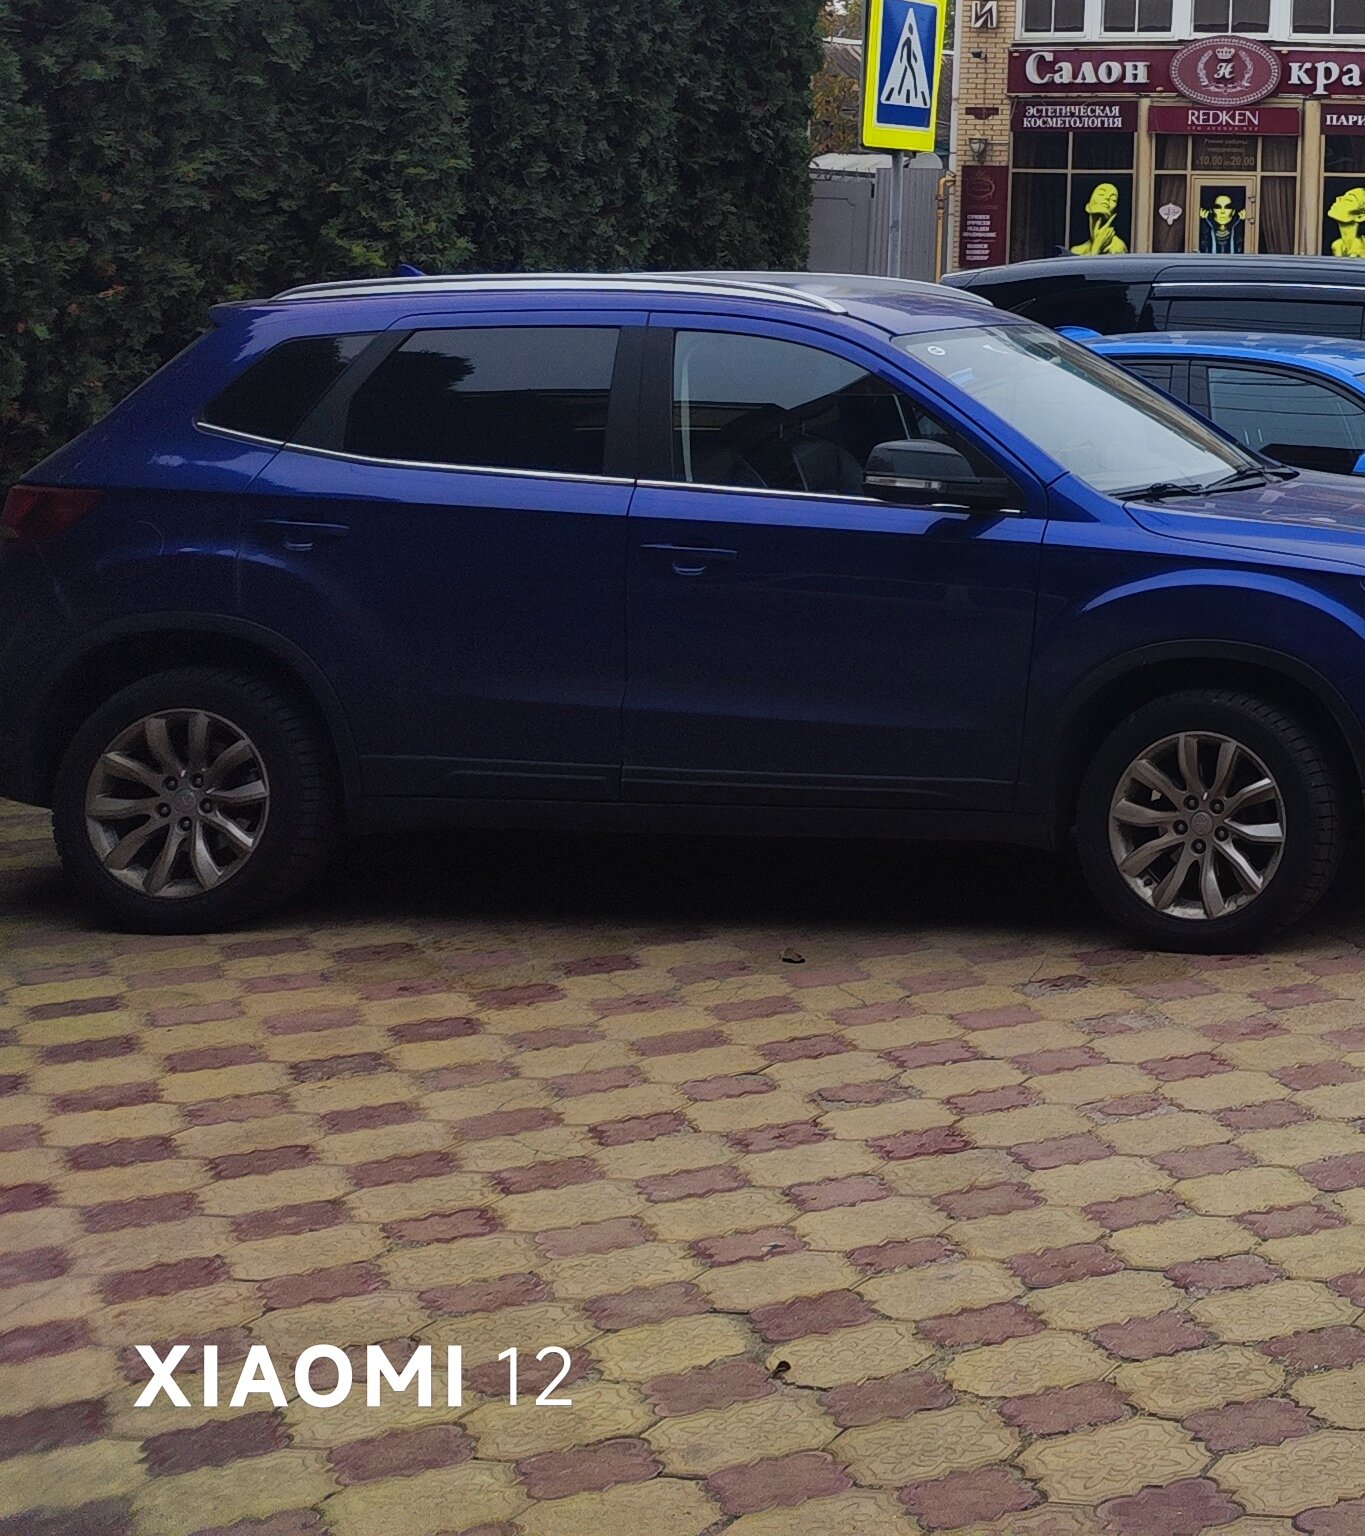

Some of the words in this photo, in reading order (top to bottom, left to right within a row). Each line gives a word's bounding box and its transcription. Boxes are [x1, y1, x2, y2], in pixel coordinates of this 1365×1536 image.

[1025, 51, 1150, 85] Салон
[1025, 105, 1121, 117] ЭСТЕТИЧЕСКАЯ
[1187, 110, 1259, 125] REDKEN
[1023, 117, 1123, 129] КОСМЕТОЛОГИЯ
